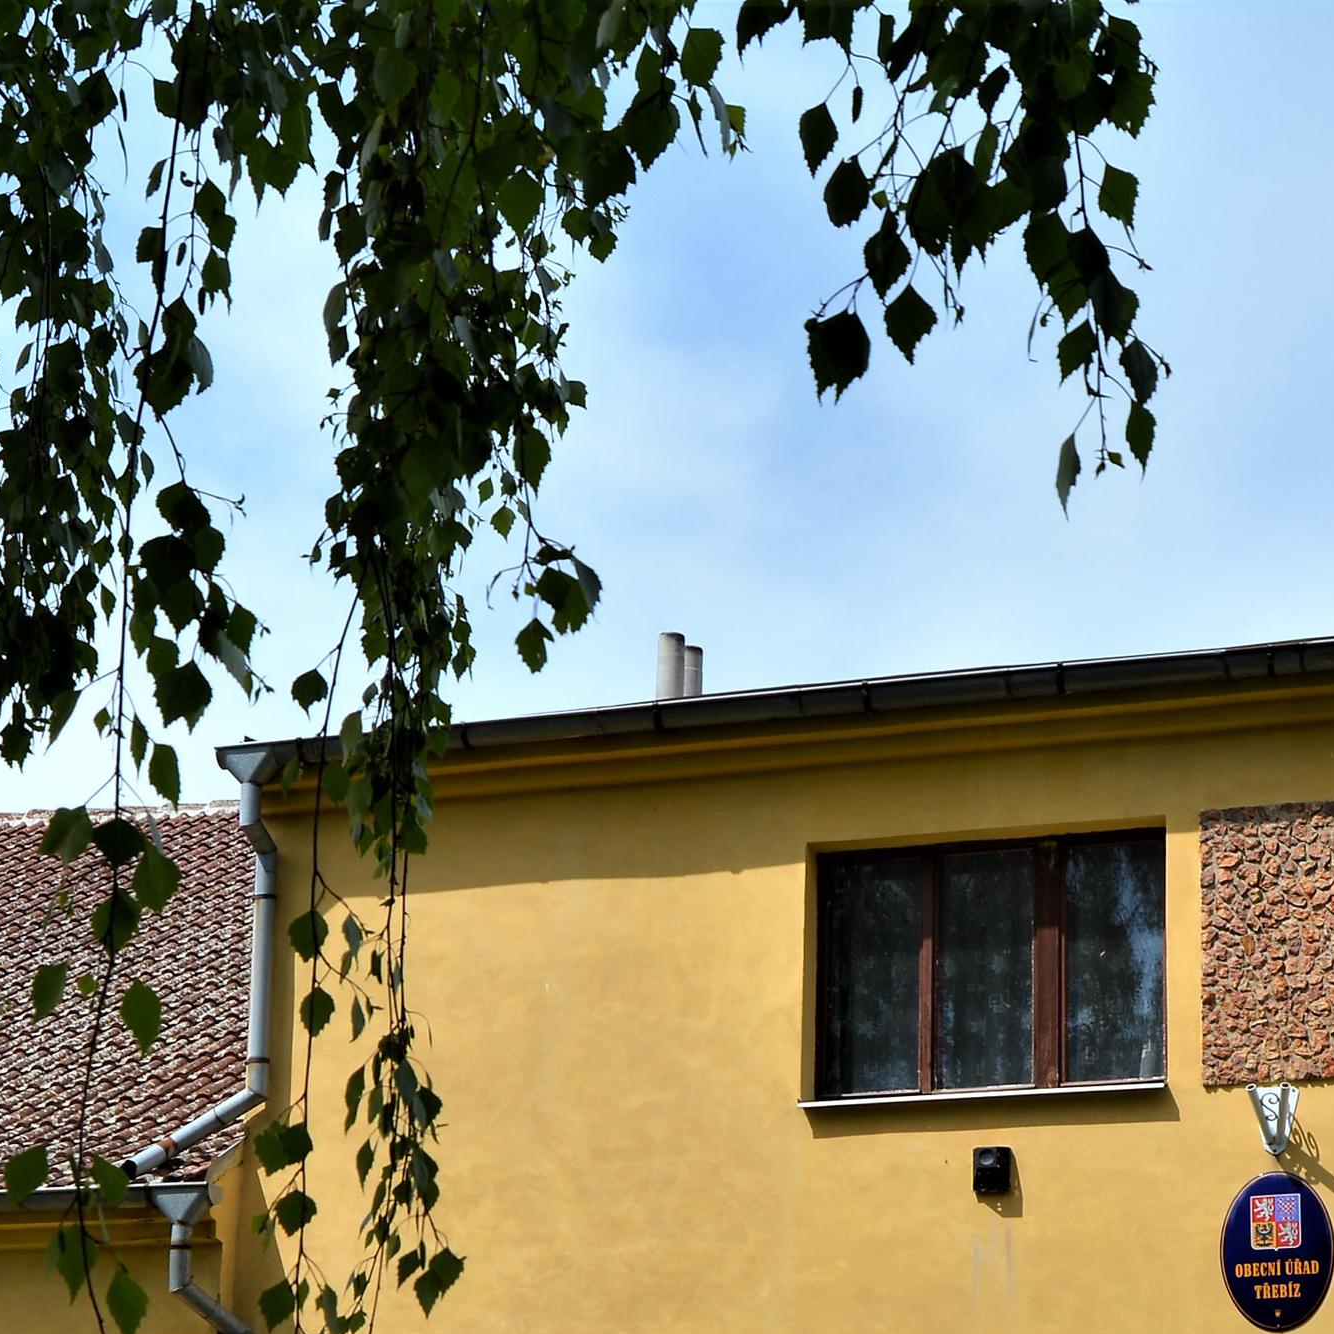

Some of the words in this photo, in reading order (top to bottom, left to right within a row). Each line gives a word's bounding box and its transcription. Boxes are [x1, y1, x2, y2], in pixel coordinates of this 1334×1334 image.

[1235, 1259, 1281, 1278] OBECNÍ
[1285, 1258, 1320, 1275] ÚŘAD
[1254, 1281, 1301, 1299] TŘEBÍZ
